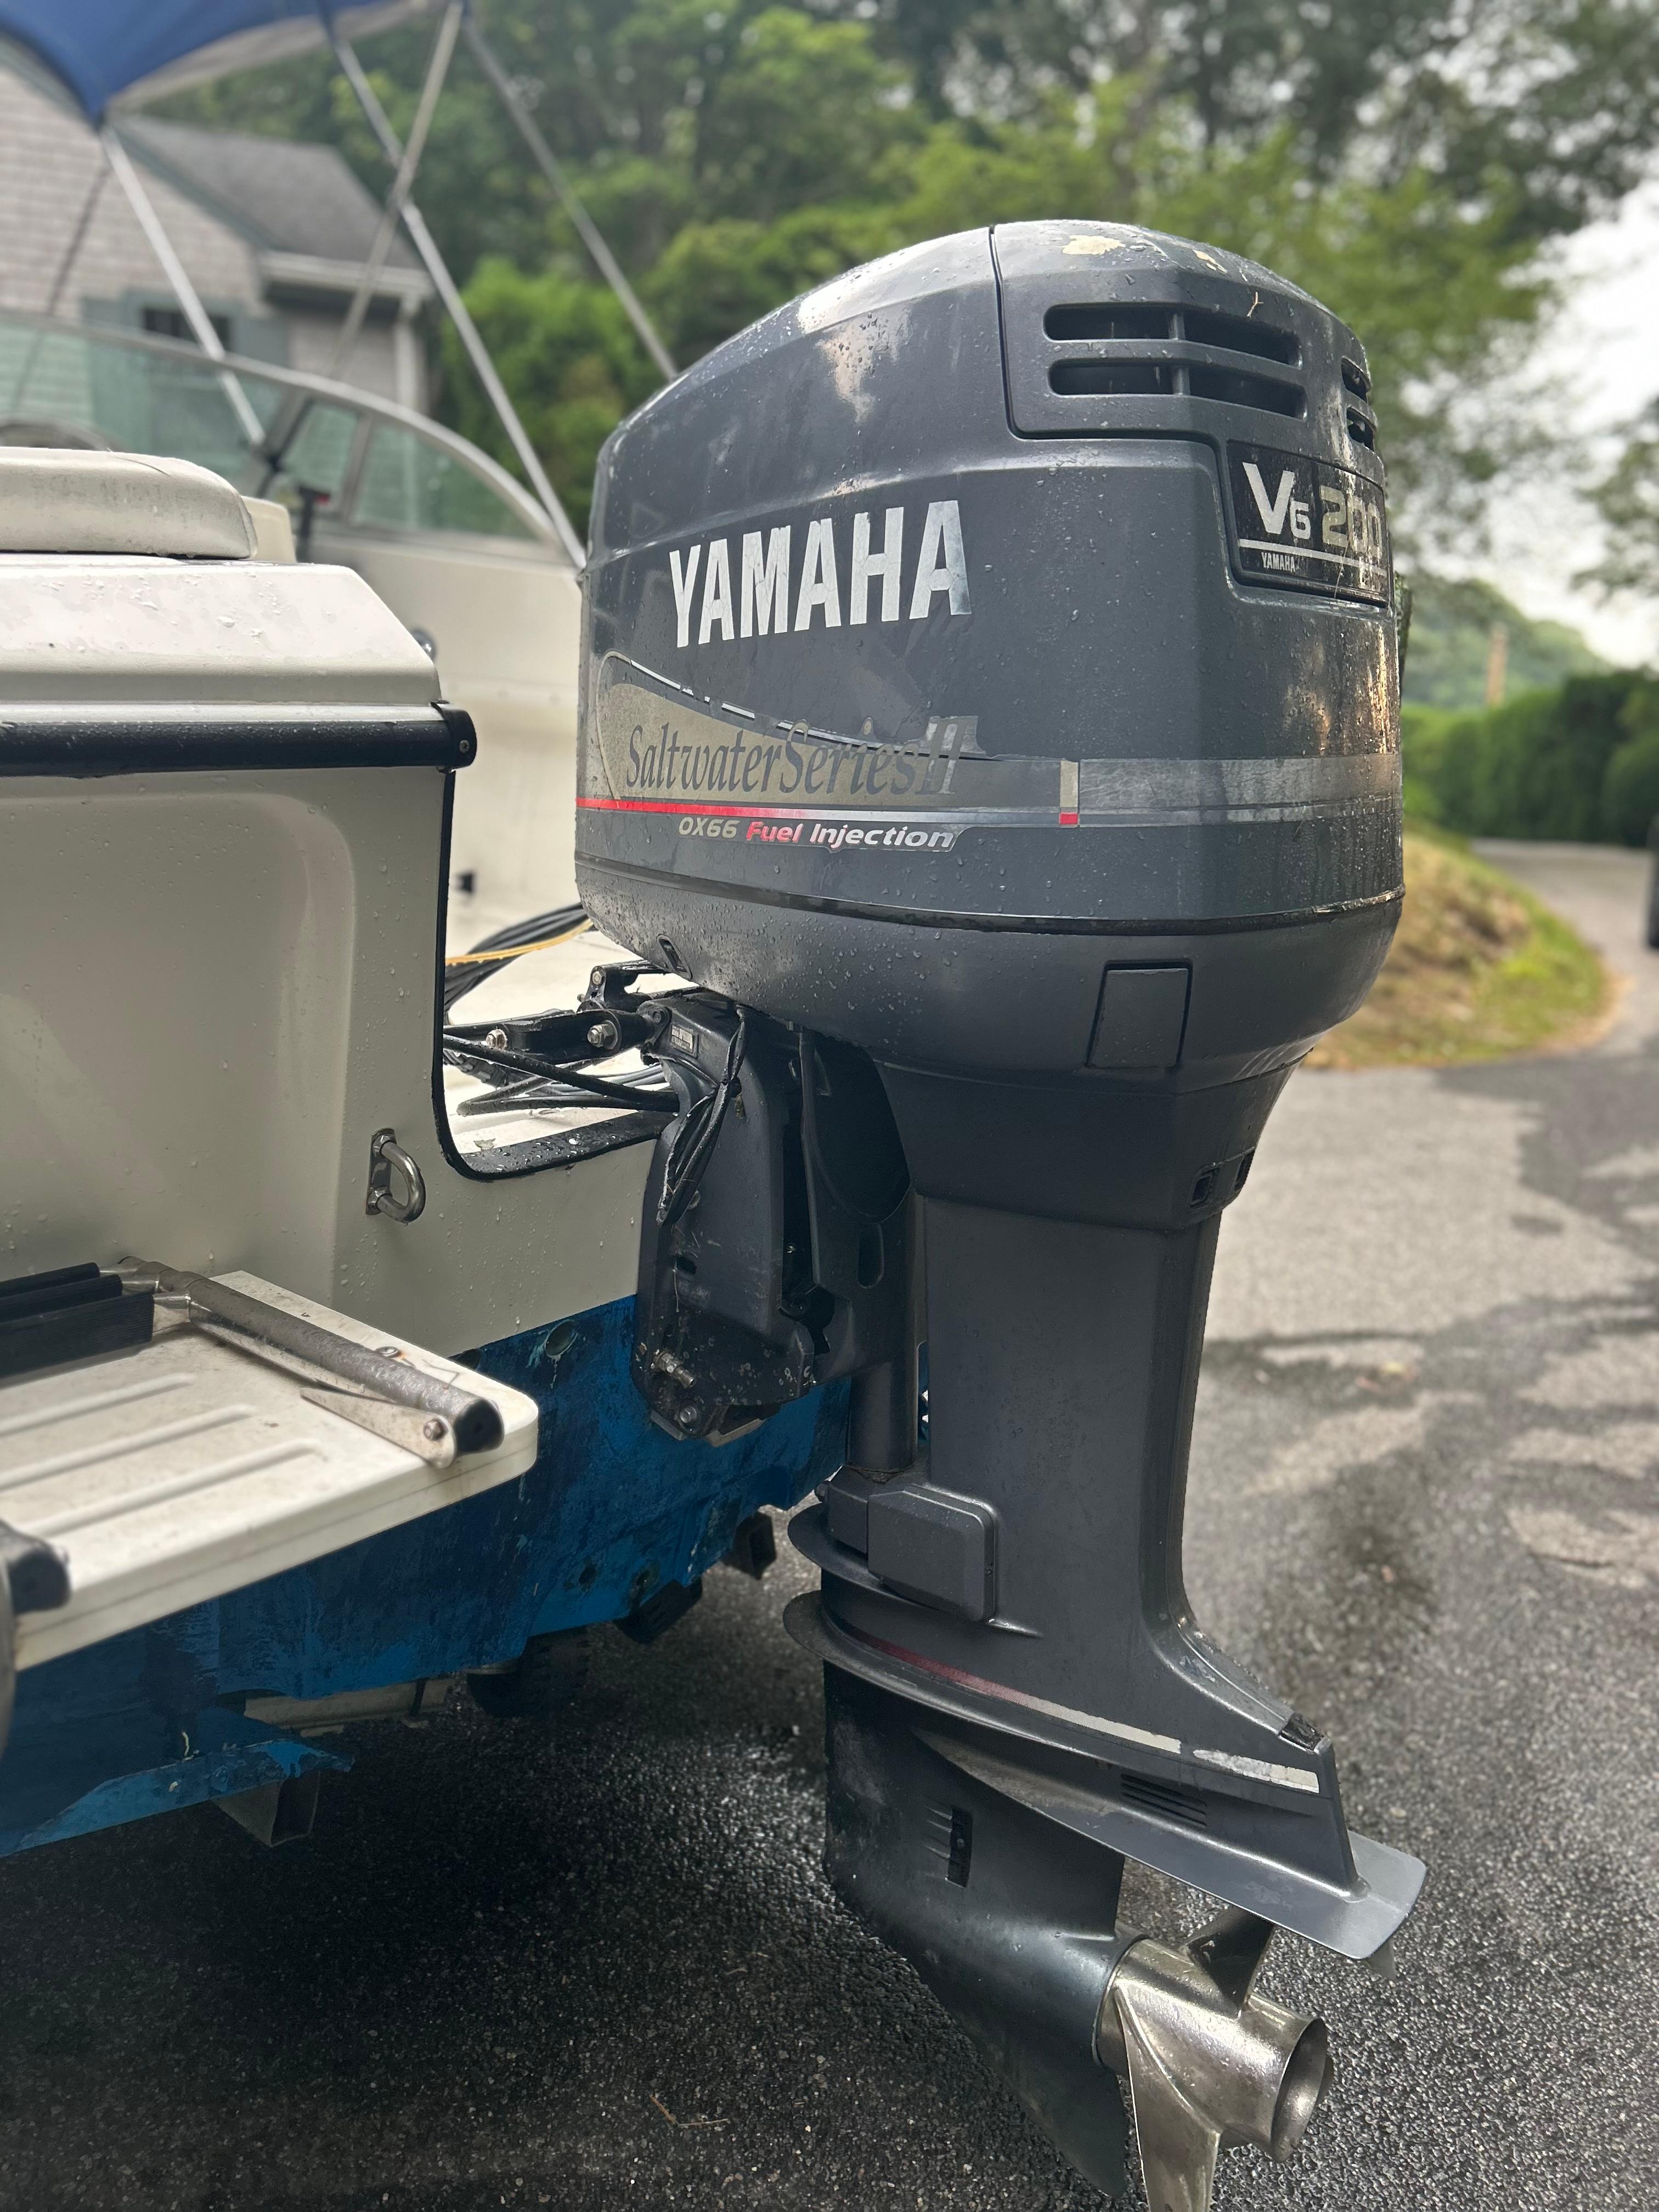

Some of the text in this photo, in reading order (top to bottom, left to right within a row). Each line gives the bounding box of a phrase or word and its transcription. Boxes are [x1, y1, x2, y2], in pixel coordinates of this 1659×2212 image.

[1242, 462, 1382, 560] V6 200
[669, 500, 972, 647] YAMAHA
[1261, 552, 1295, 572] YAMAHA
[746, 821, 804, 843] Fuel
[809, 824, 954, 849] Injection
